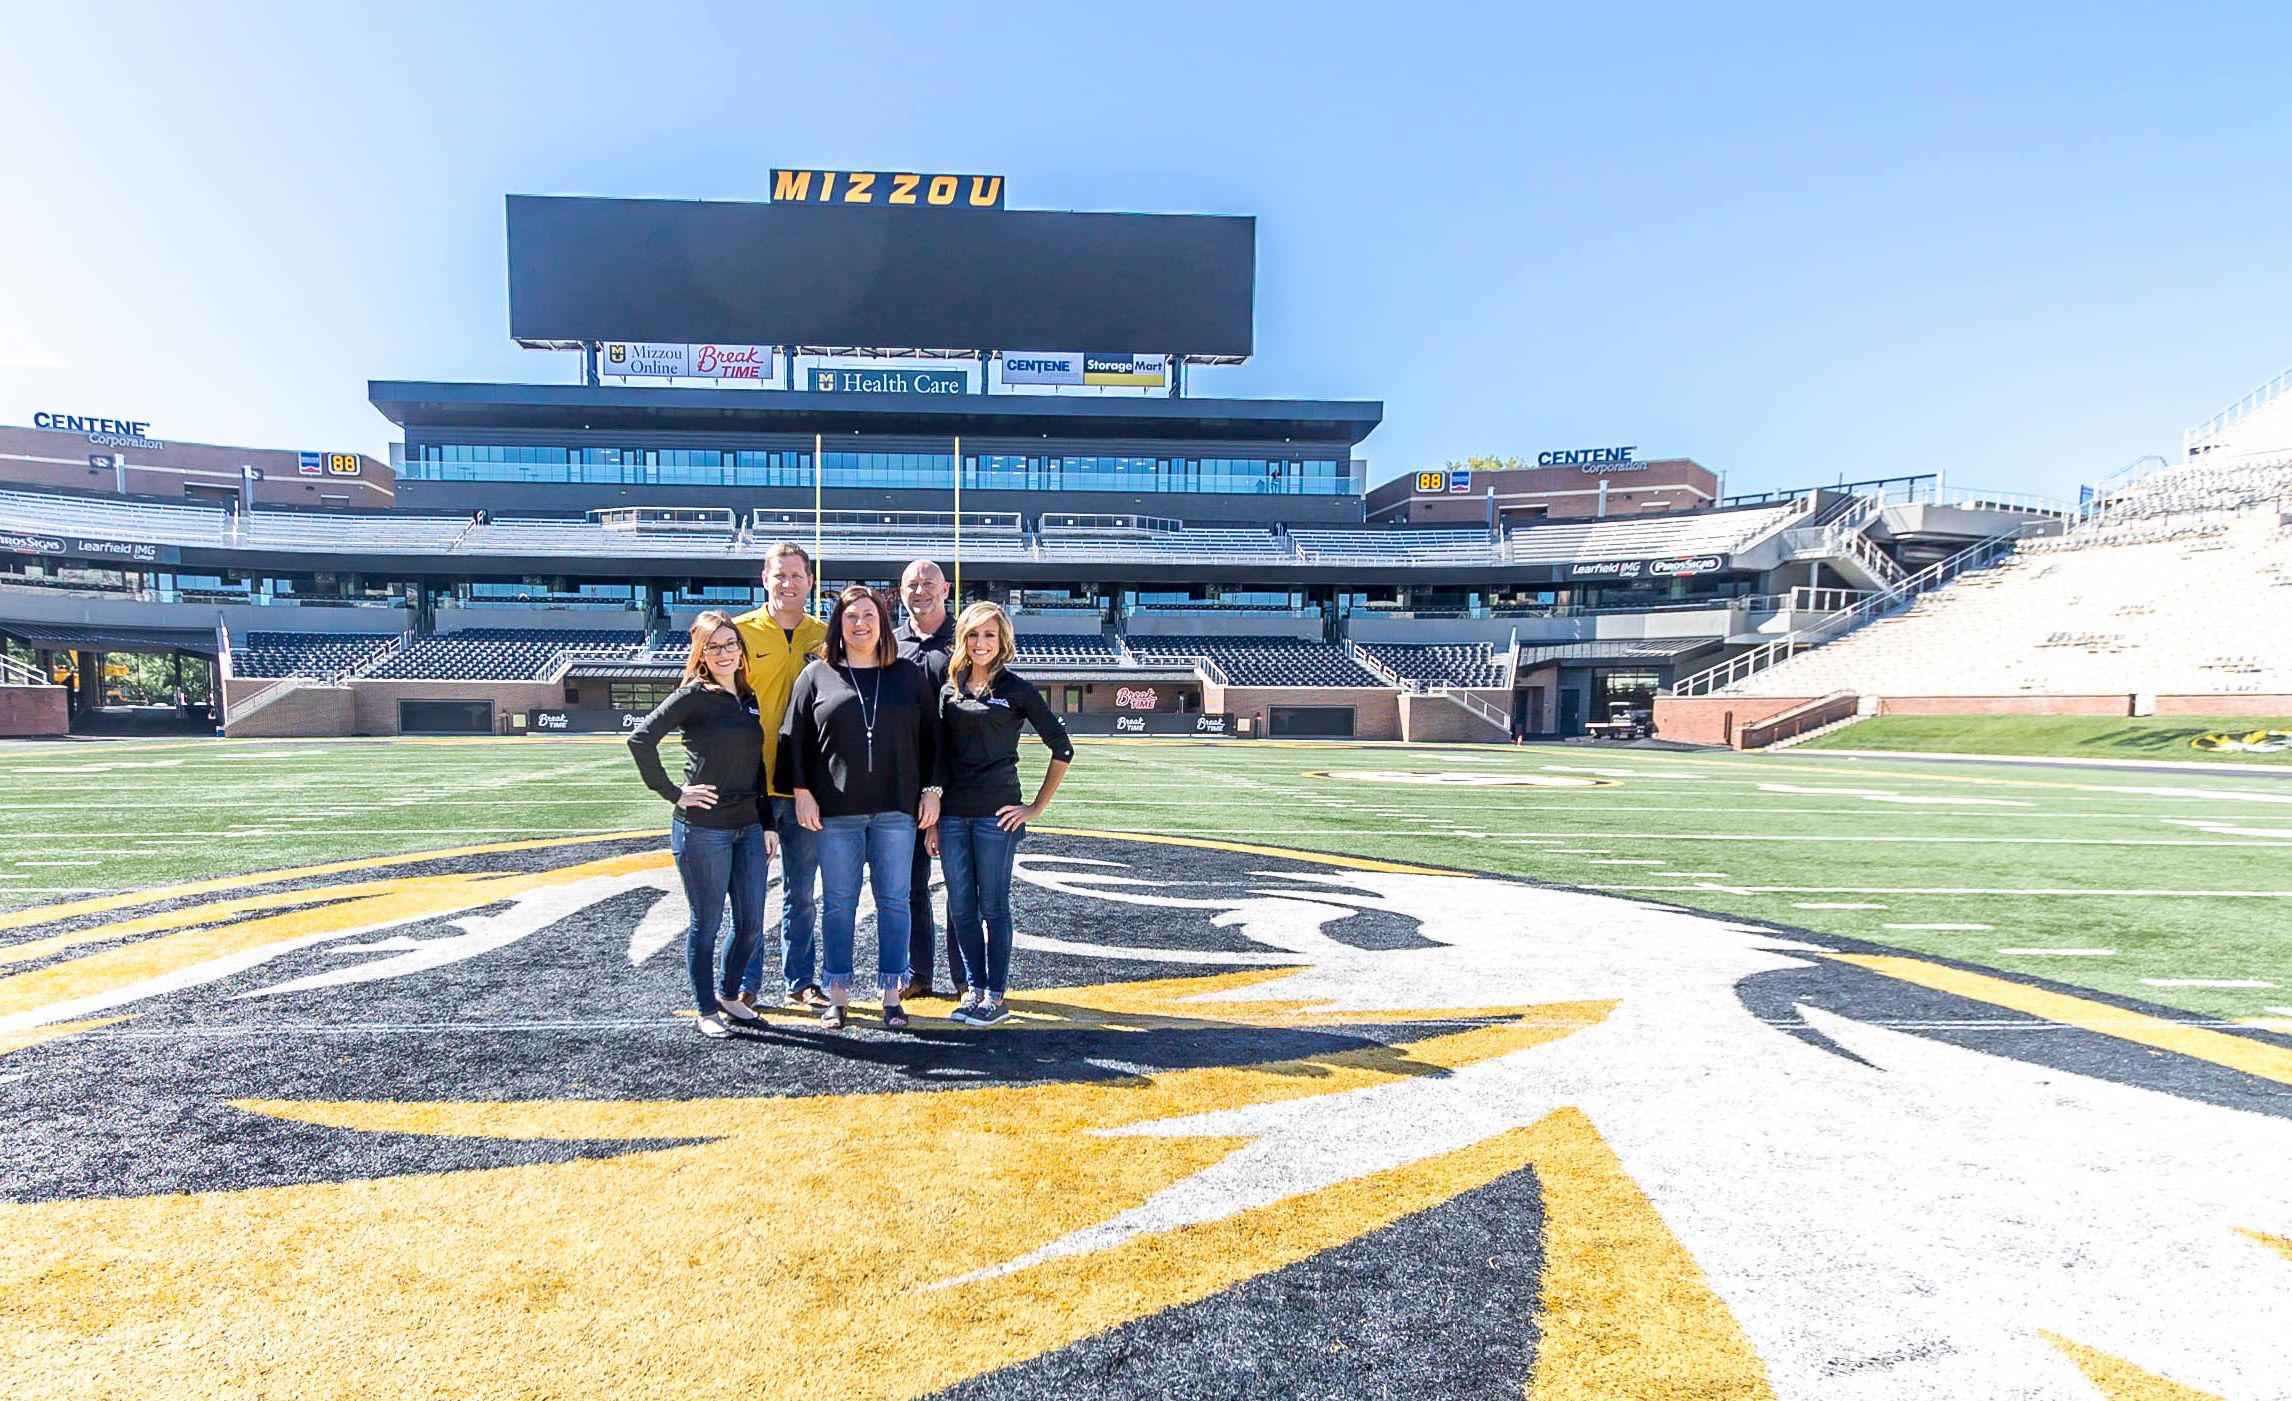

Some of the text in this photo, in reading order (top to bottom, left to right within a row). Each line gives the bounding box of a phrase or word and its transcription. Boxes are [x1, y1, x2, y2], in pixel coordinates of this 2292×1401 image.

[773, 170, 1001, 207] MIZZOU
[631, 345, 682, 360] Mizzou
[697, 345, 764, 373] Break
[630, 360, 678, 375] Online
[721, 365, 761, 379] TIME
[1006, 359, 1071, 376] CENTENE
[843, 373, 959, 393] Health Care
[33, 412, 151, 437] CENTENE
[88, 432, 164, 450] Corporation
[1538, 446, 1637, 465] CENTENE
[333, 455, 355, 472] 88
[1581, 461, 1648, 474] Corporation
[1421, 473, 1440, 489] 88
[78, 540, 156, 556] Learfield IMG
[1572, 561, 1642, 575] Learfield IMG
[1116, 687, 1158, 707] Break
[1130, 699, 1155, 709] TIME
[538, 713, 569, 727] Break
[622, 713, 646, 727] Brea
[1116, 716, 1146, 730] Break
[1197, 717, 1226, 731] Break
[1127, 724, 1144, 732] TIME
[1207, 724, 1224, 732] TIME
